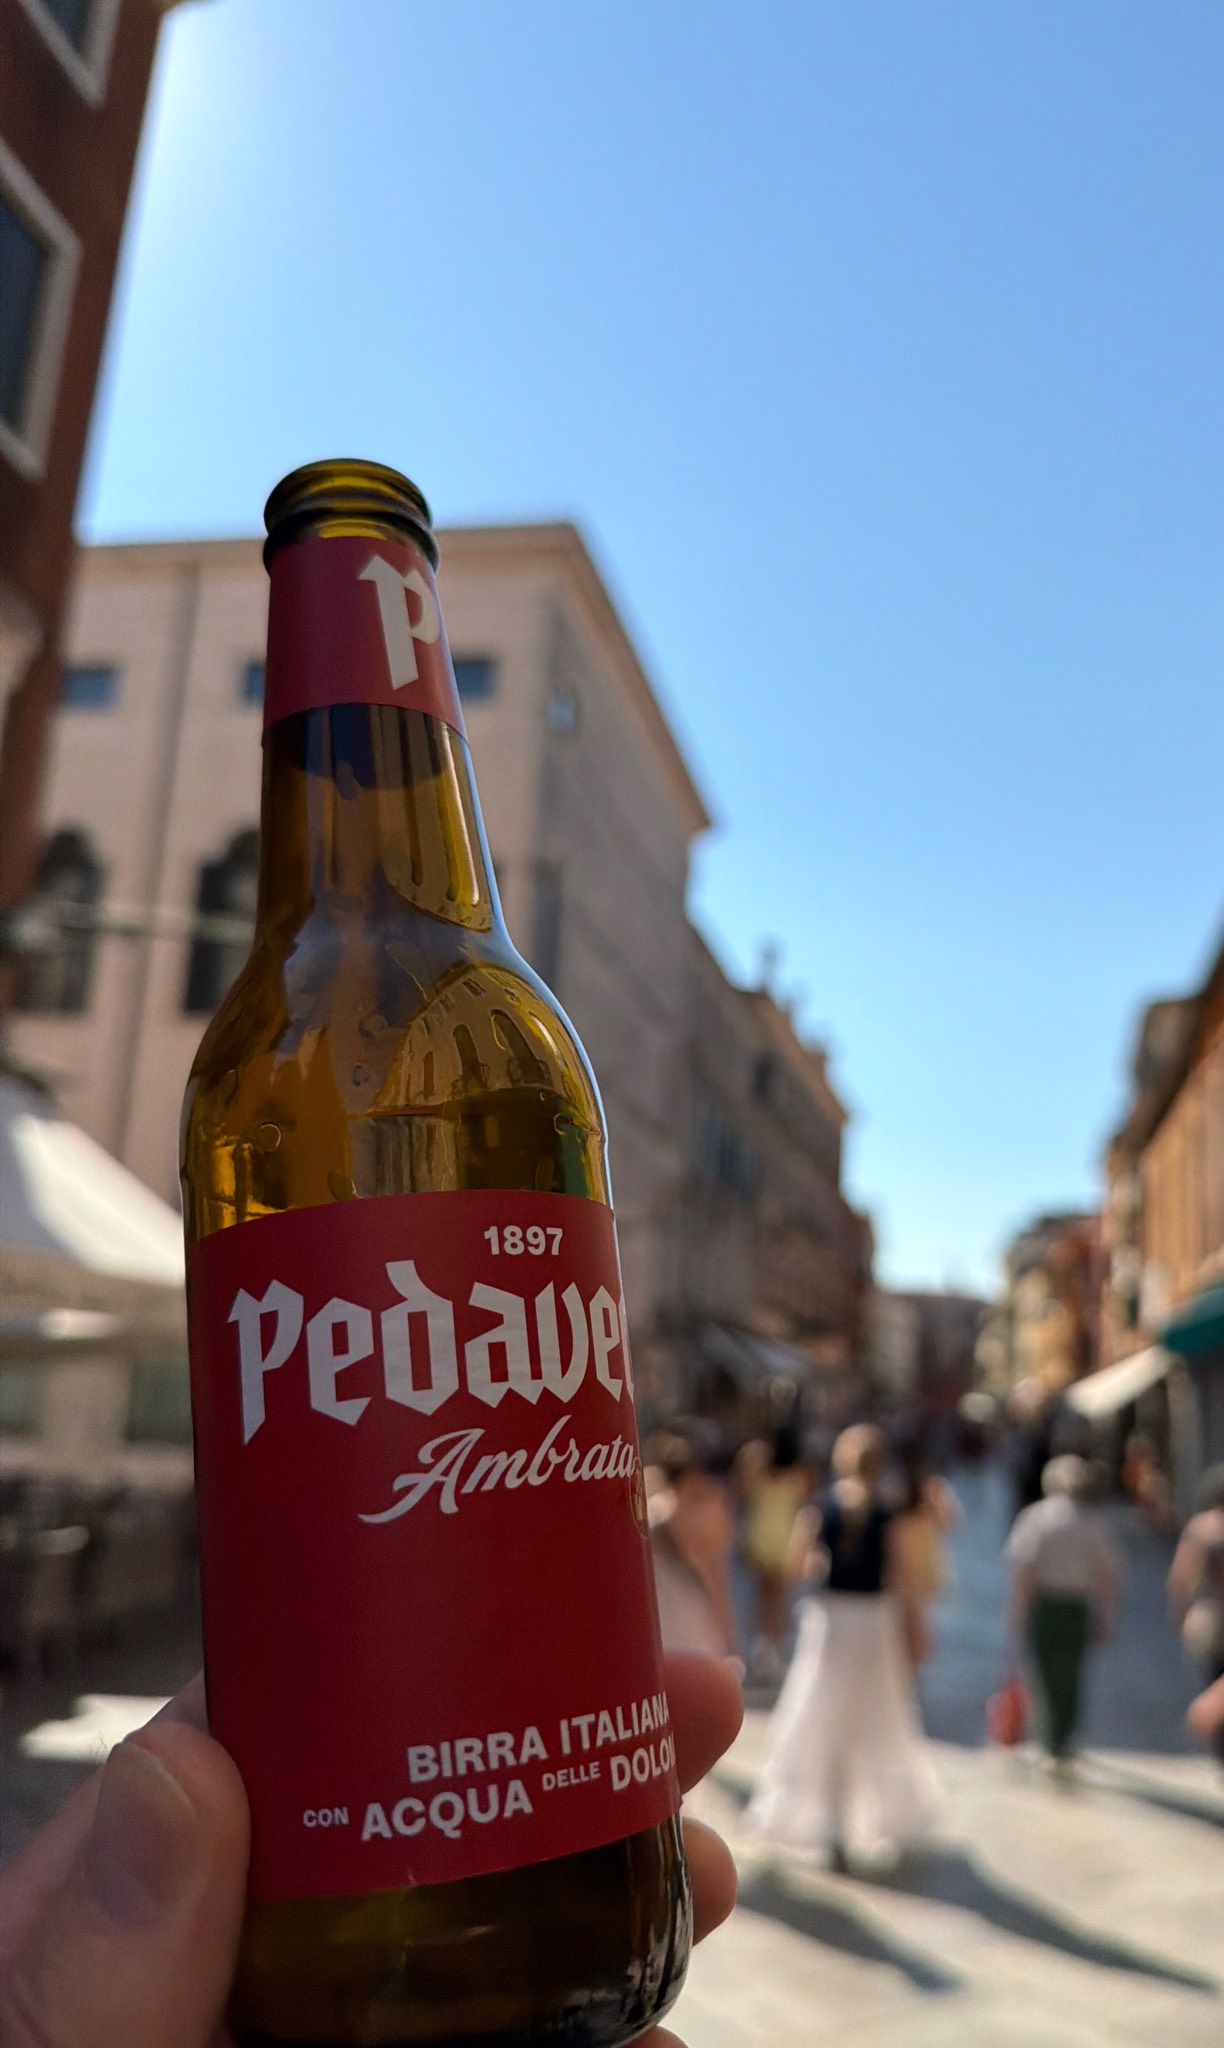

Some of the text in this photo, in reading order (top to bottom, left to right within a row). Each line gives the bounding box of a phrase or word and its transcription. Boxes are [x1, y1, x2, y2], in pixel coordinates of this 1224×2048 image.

[484, 1225, 563, 1256] 1897
[228, 1260, 634, 1445] Pedave
[358, 1415, 634, 1524] Ambrata
[407, 1726, 547, 1783] BIRRA
[303, 1806, 349, 1828] CON
[361, 1779, 534, 1841] ACQUA
[542, 1762, 601, 1791] DELLE
